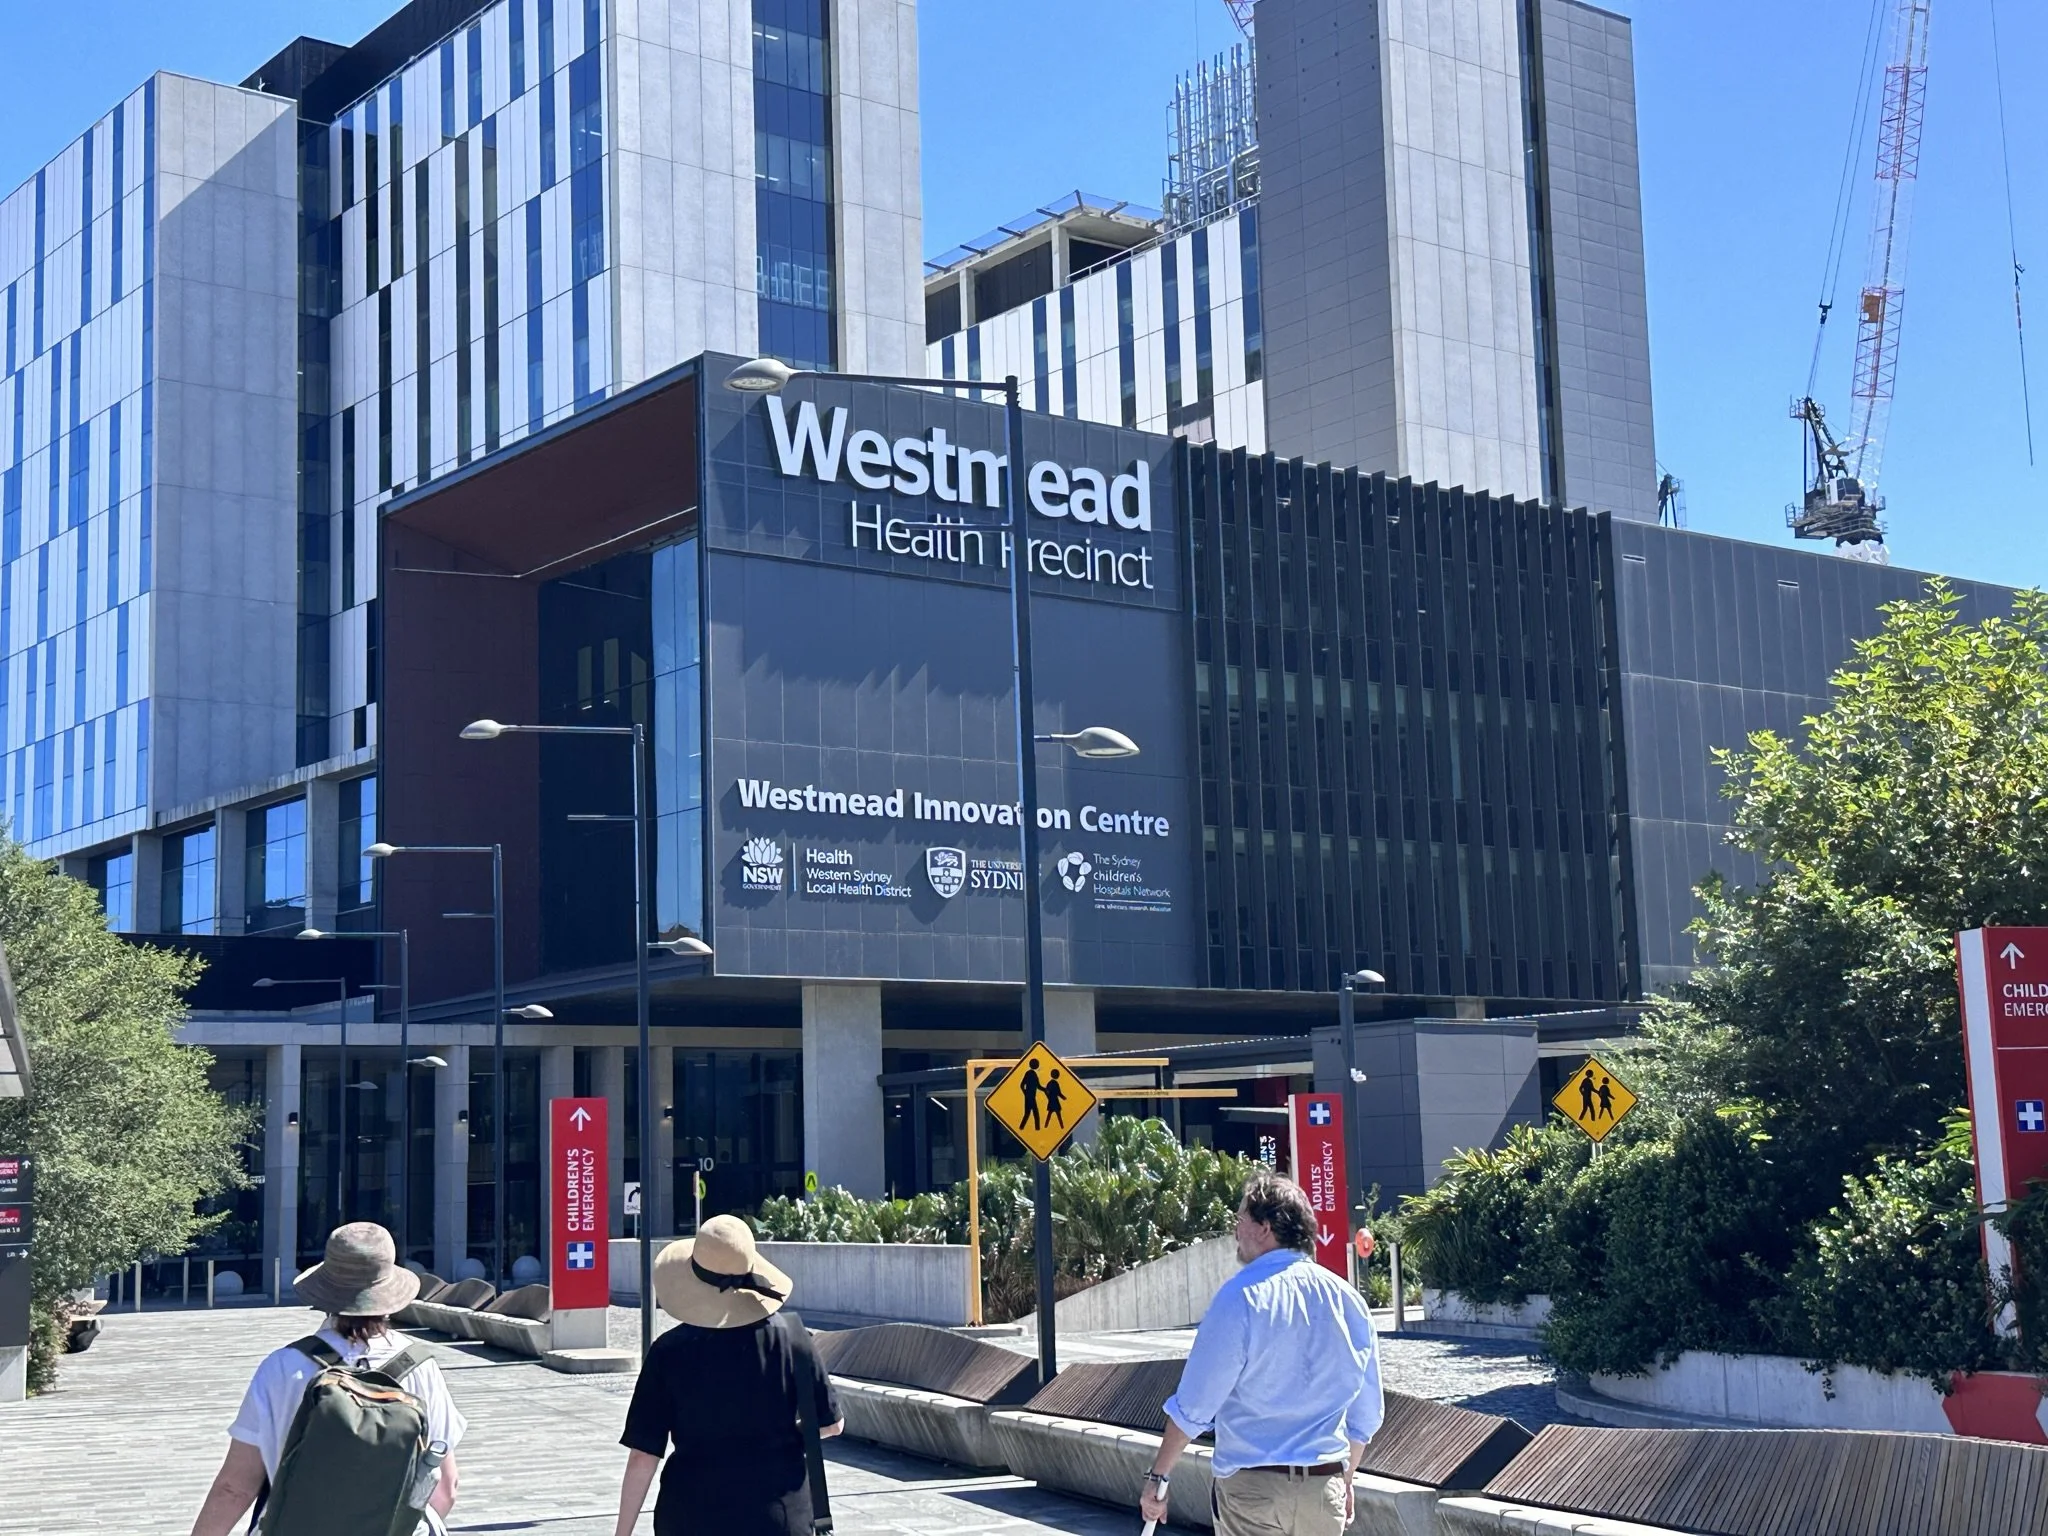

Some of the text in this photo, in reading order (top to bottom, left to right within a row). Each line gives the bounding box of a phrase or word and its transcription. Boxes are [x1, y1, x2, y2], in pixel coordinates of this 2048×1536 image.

[765, 394, 1152, 532] Westmead
[851, 500, 984, 565] Health
[737, 778, 1170, 837] Westmead Innovaton Centre
[806, 847, 853, 865] Health
[971, 859, 987, 869] THE
[1093, 853, 1142, 869] The Sydney
[742, 866, 784, 884] NSW
[806, 867, 892, 885] Western Sydney
[971, 869, 1025, 891] SYDN
[806, 881, 912, 898] Local Health District
[1093, 883, 1171, 898] Hospitals Network
[698, 1157, 714, 1172] 10
[1322, 1141, 1336, 1212] EMERGENCY
[567, 1148, 580, 1232] CHILDREN'S
[582, 1148, 595, 1232] EMERGENCY
